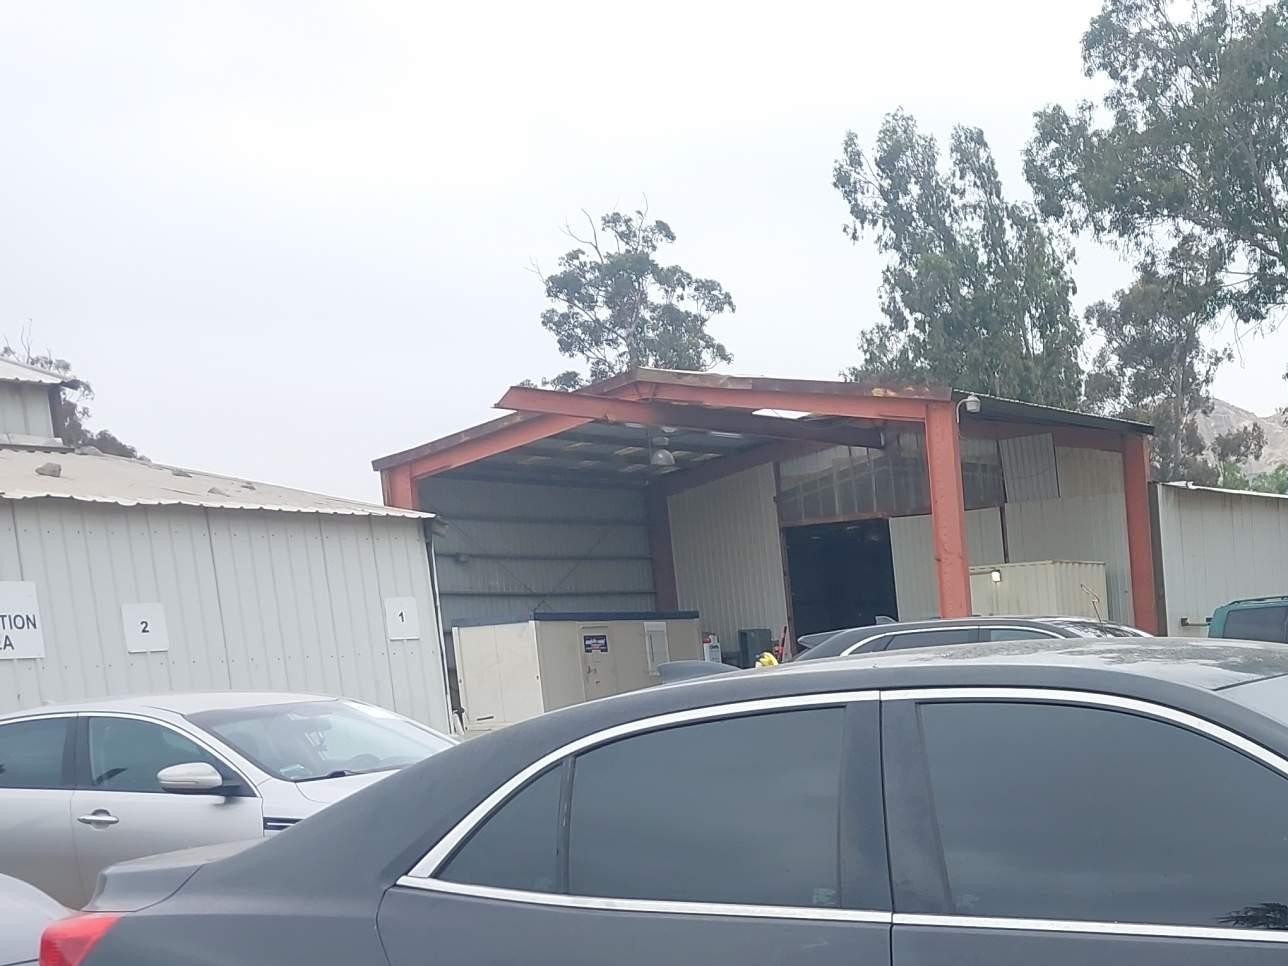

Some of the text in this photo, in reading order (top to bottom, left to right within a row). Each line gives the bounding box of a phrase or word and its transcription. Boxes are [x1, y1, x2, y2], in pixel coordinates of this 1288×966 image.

[399, 611, 405, 623] 1
[140, 620, 150, 633] 2
[0, 634, 15, 650] A
